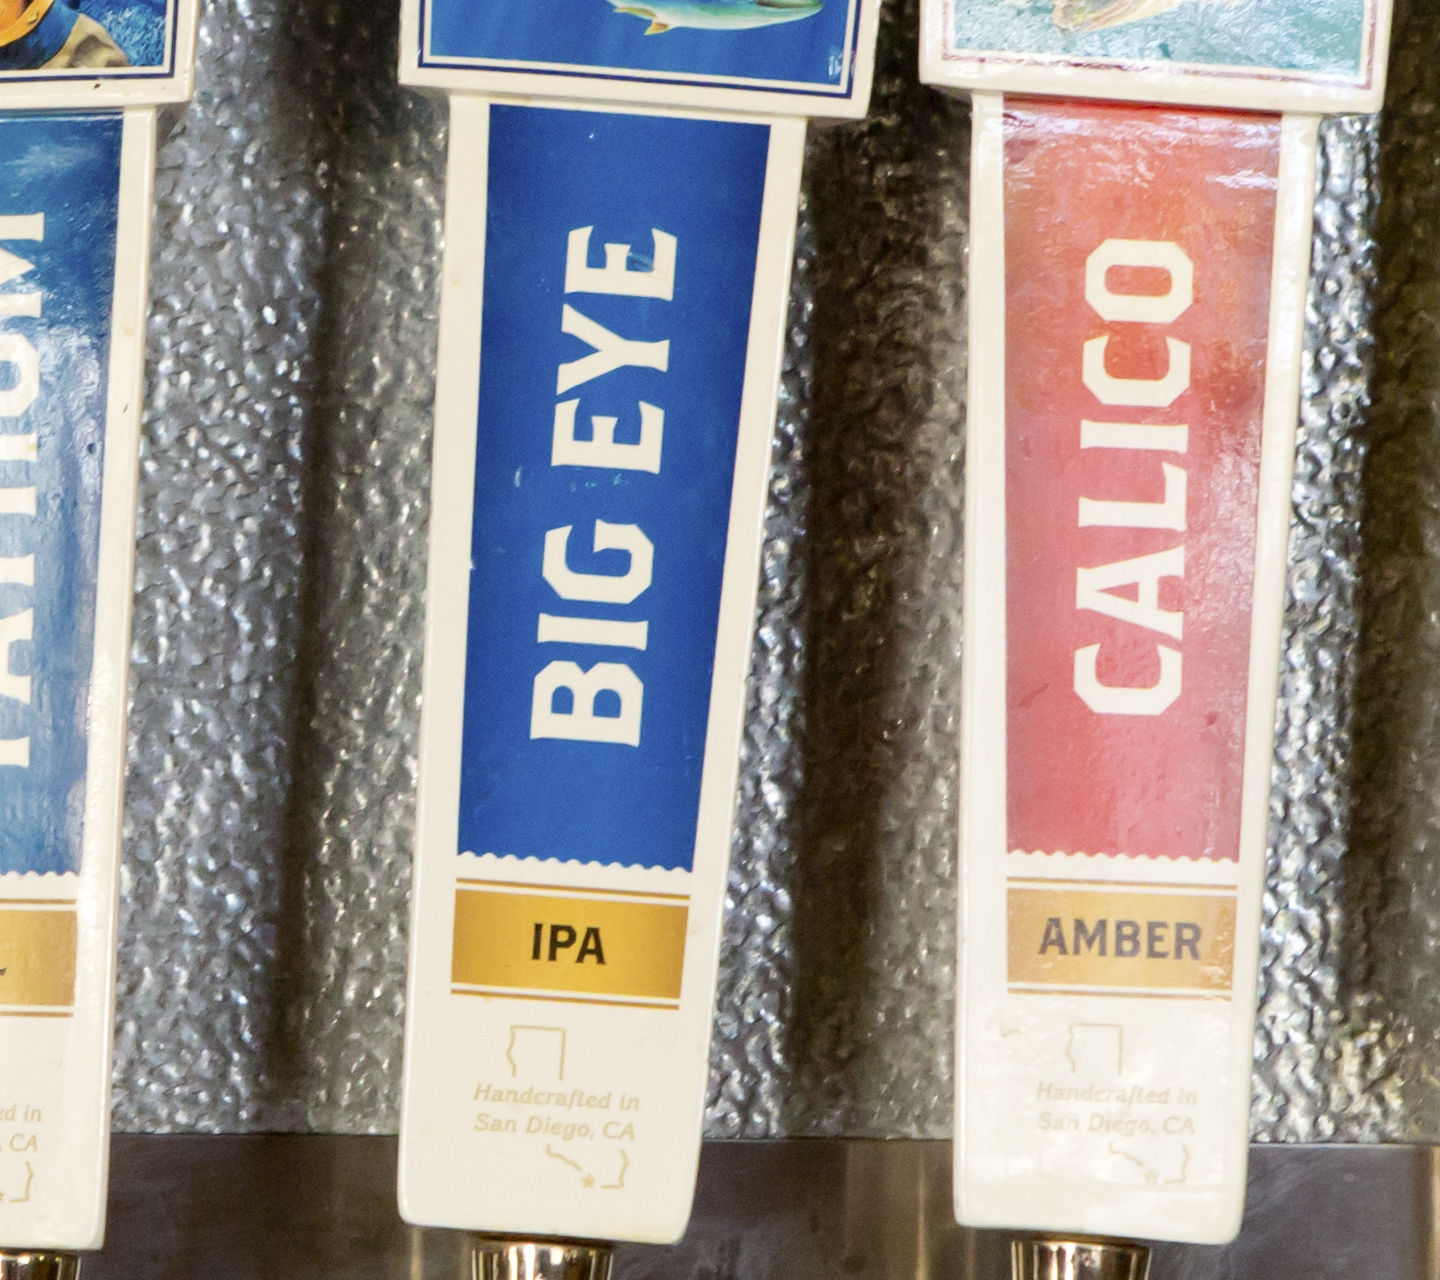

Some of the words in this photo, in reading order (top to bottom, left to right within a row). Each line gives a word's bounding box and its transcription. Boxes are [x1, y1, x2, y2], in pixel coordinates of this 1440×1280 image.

[551, 224, 679, 475] EYE
[1073, 238, 1193, 718] CALICO
[529, 518, 655, 748] BIG
[530, 923, 607, 966] IPA
[1038, 917, 1202, 961] AMBER
[24, 1105, 42, 1122] in
[474, 1083, 612, 1110] Handcrafted
[619, 1093, 640, 1111] in
[9, 1134, 38, 1152] CA
[475, 1113, 517, 1132] San
[526, 1115, 594, 1140] Diego,
[602, 1121, 635, 1140] CA
